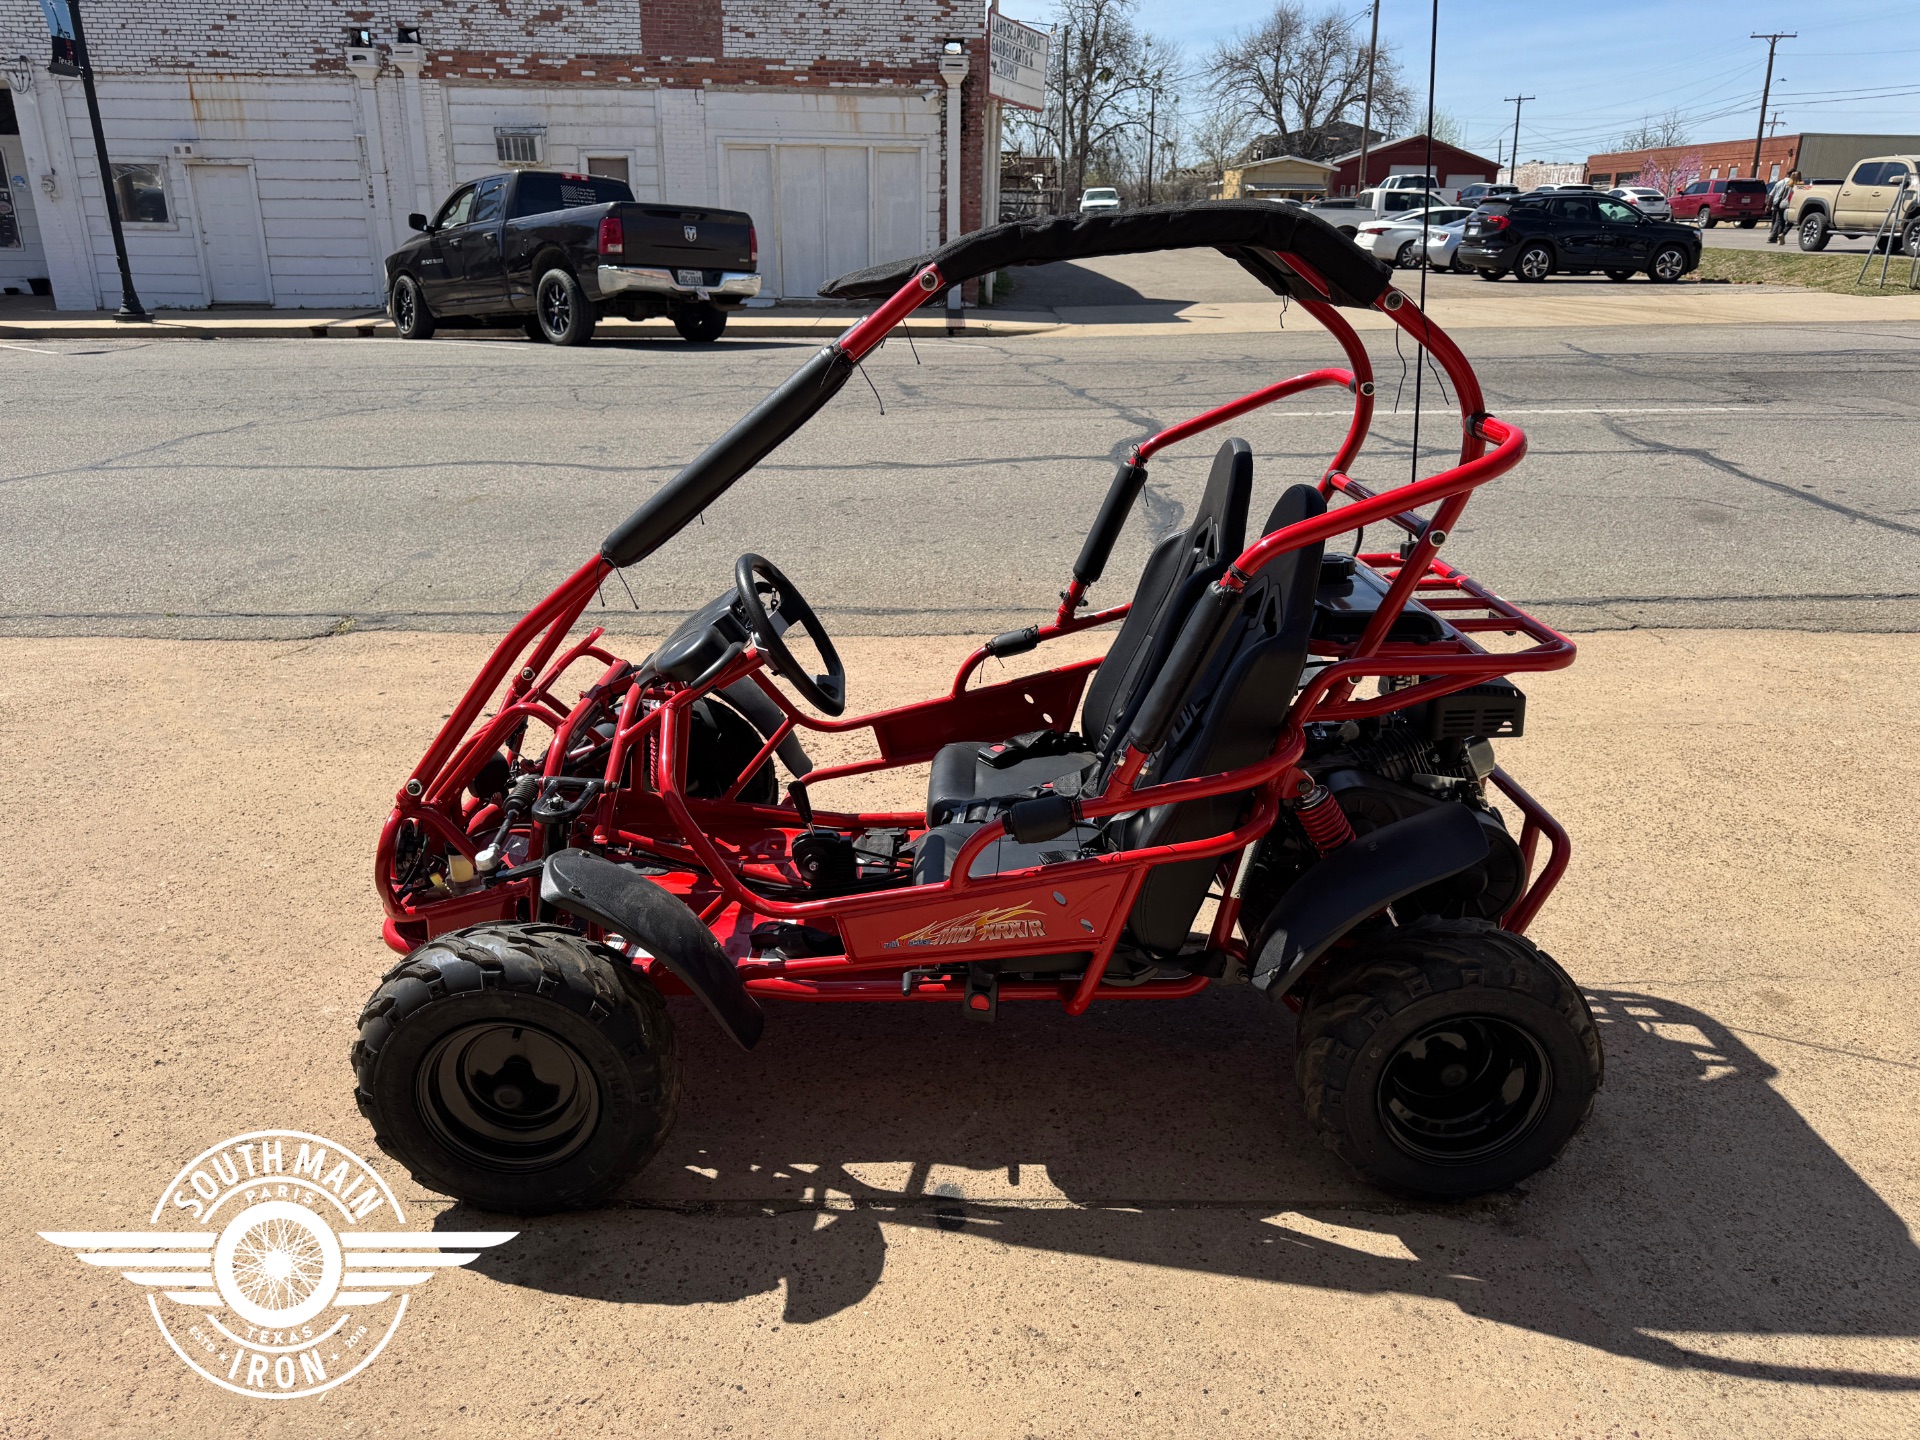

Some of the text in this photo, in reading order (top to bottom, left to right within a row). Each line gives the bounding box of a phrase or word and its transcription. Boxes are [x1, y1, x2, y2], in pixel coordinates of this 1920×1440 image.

[992, 17, 1041, 51] LANDSCAPE TOOLS
[58, 56, 74, 66] Texas
[933, 919, 1048, 945] MID XRX/R
